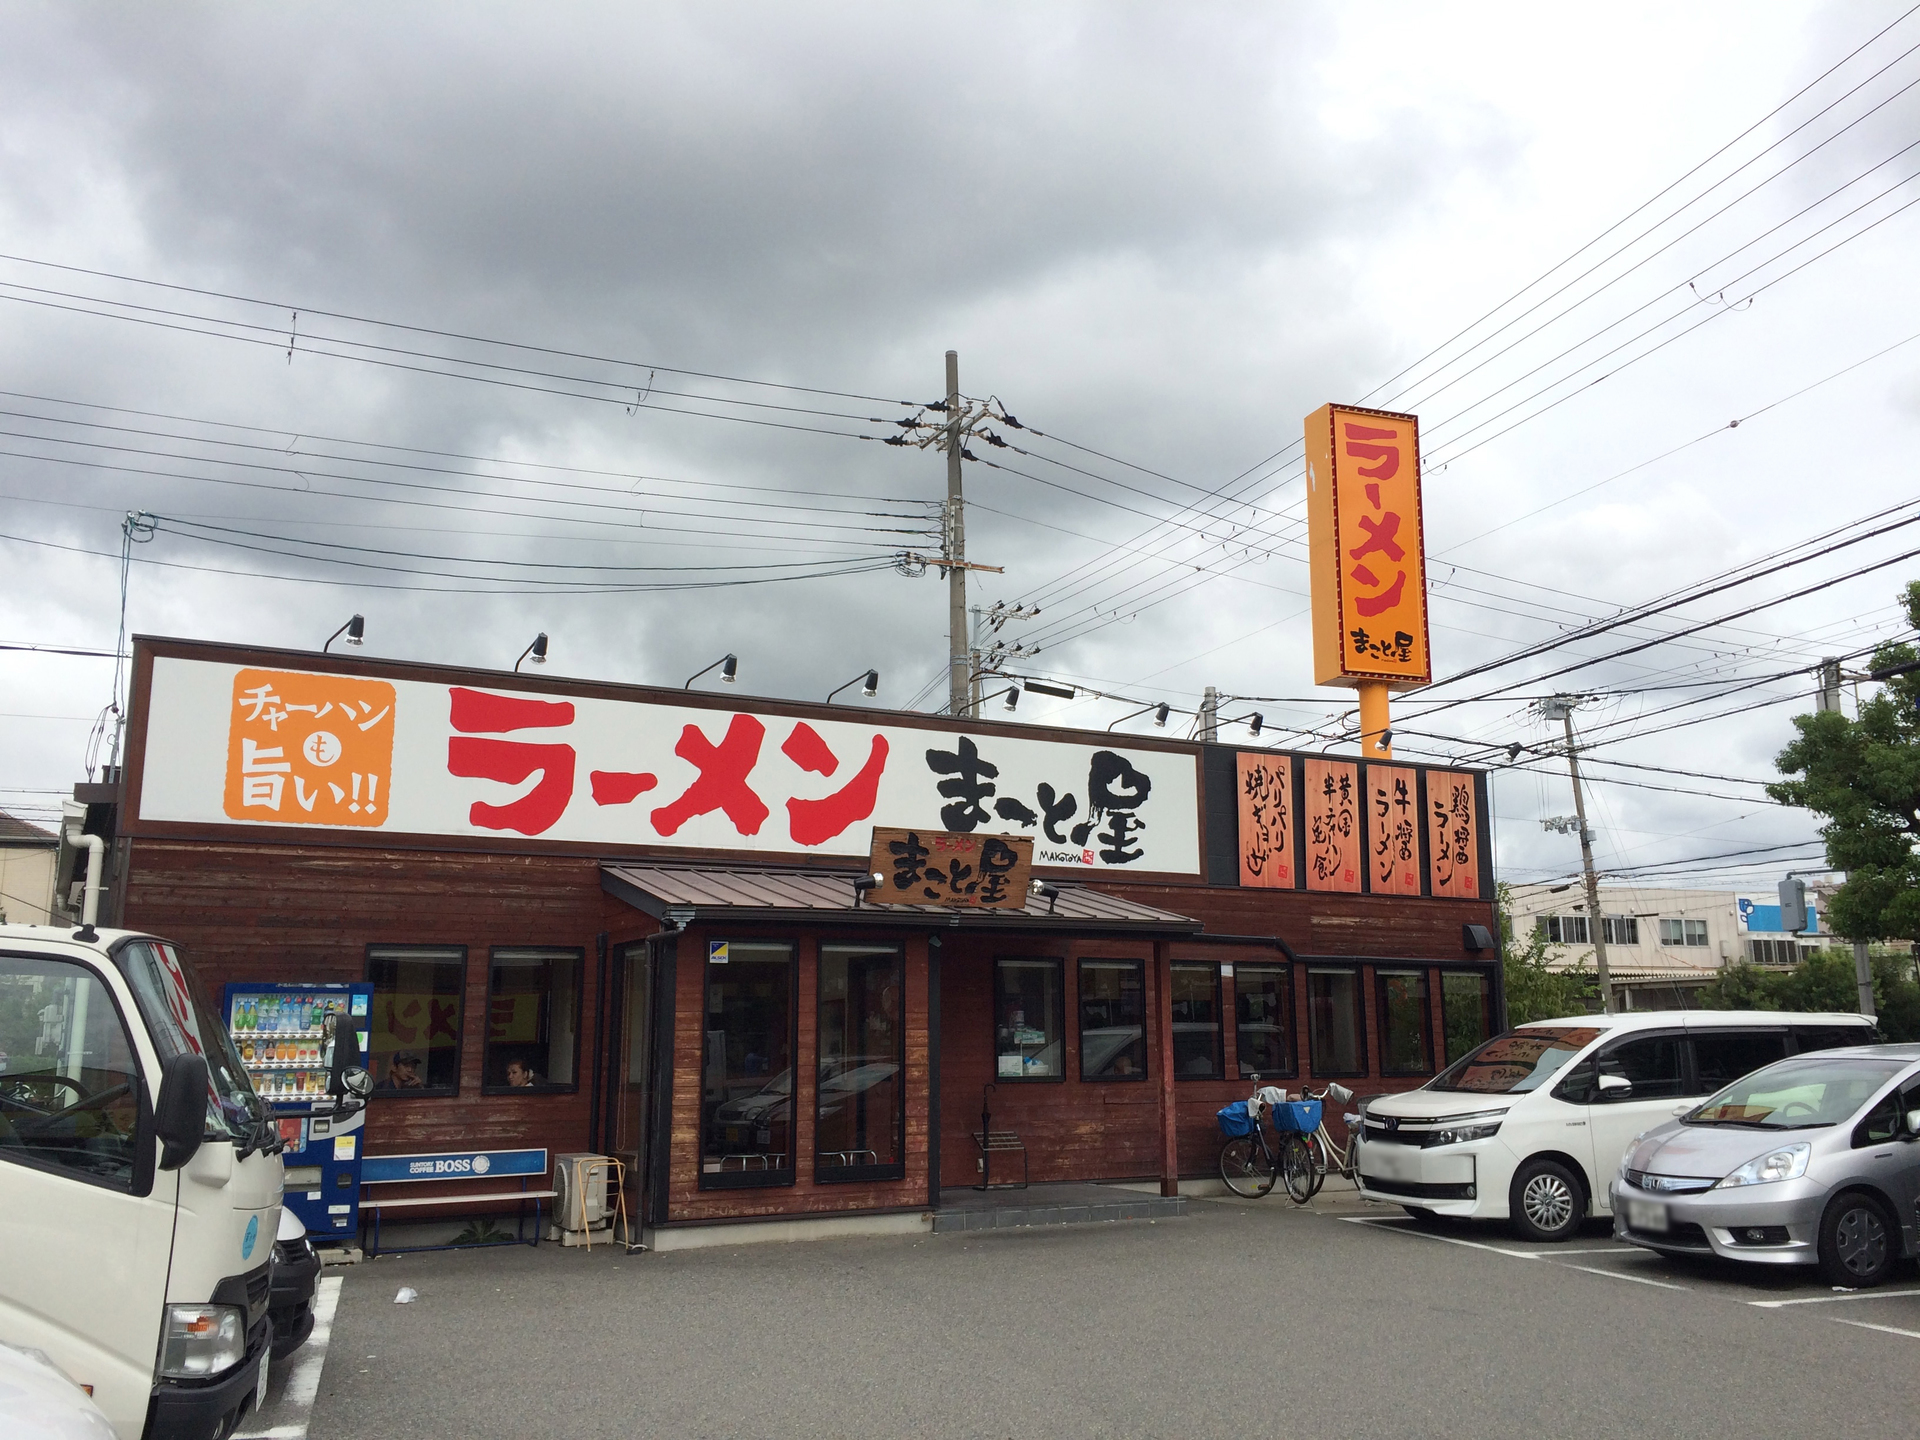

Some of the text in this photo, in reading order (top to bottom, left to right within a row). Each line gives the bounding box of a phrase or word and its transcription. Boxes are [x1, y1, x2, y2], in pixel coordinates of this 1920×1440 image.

[1344, 423, 1406, 617] ラーメン
[1350, 627, 1413, 662] まこと屋
[238, 683, 389, 732] チャーハン
[309, 735, 335, 763] も
[448, 687, 889, 846] ラーメン
[1269, 765, 1287, 853] パリパリ
[1338, 773, 1352, 838] 黄金
[934, 836, 977, 853] ラーメン
[1038, 850, 1082, 865] MAKOTOYA
[1375, 788, 1396, 883] ラーメン
[1433, 800, 1455, 887] ラーメン
[889, 831, 1018, 904] まこと屋
[409, 1166, 434, 1174] COFFEE
[435, 1159, 470, 1173] BOSS
